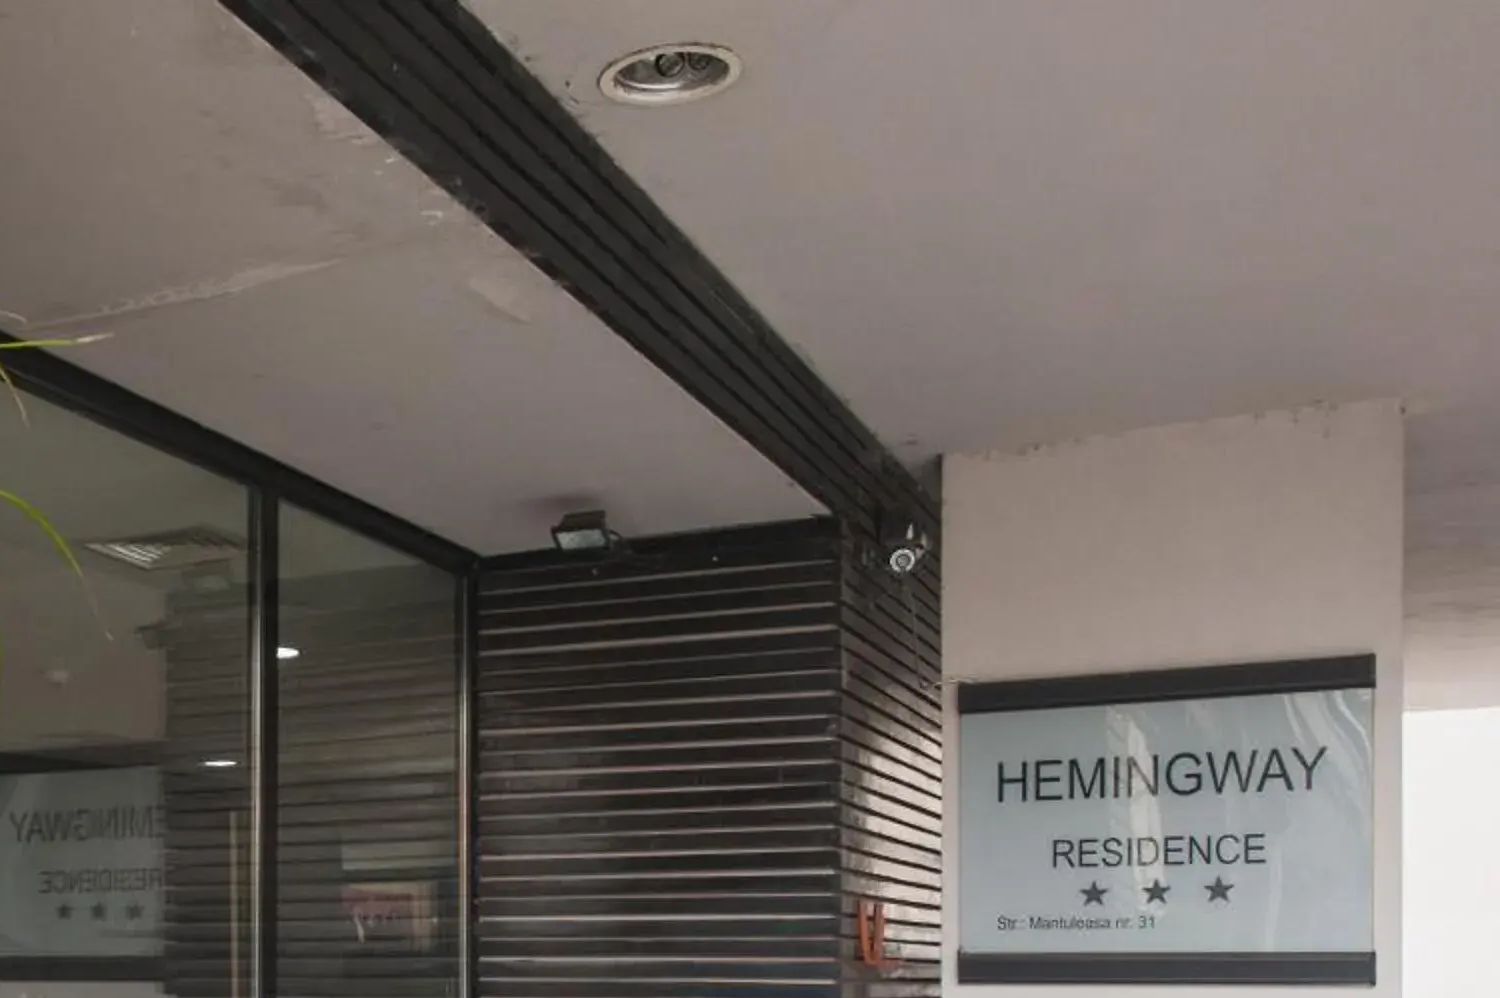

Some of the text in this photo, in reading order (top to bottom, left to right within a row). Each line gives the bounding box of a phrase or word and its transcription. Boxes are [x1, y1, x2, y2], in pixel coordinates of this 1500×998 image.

[997, 746, 1327, 802] HEMINGWAY
[1052, 834, 1267, 869] RESIDENCE
[1138, 915, 1155, 929] 31
